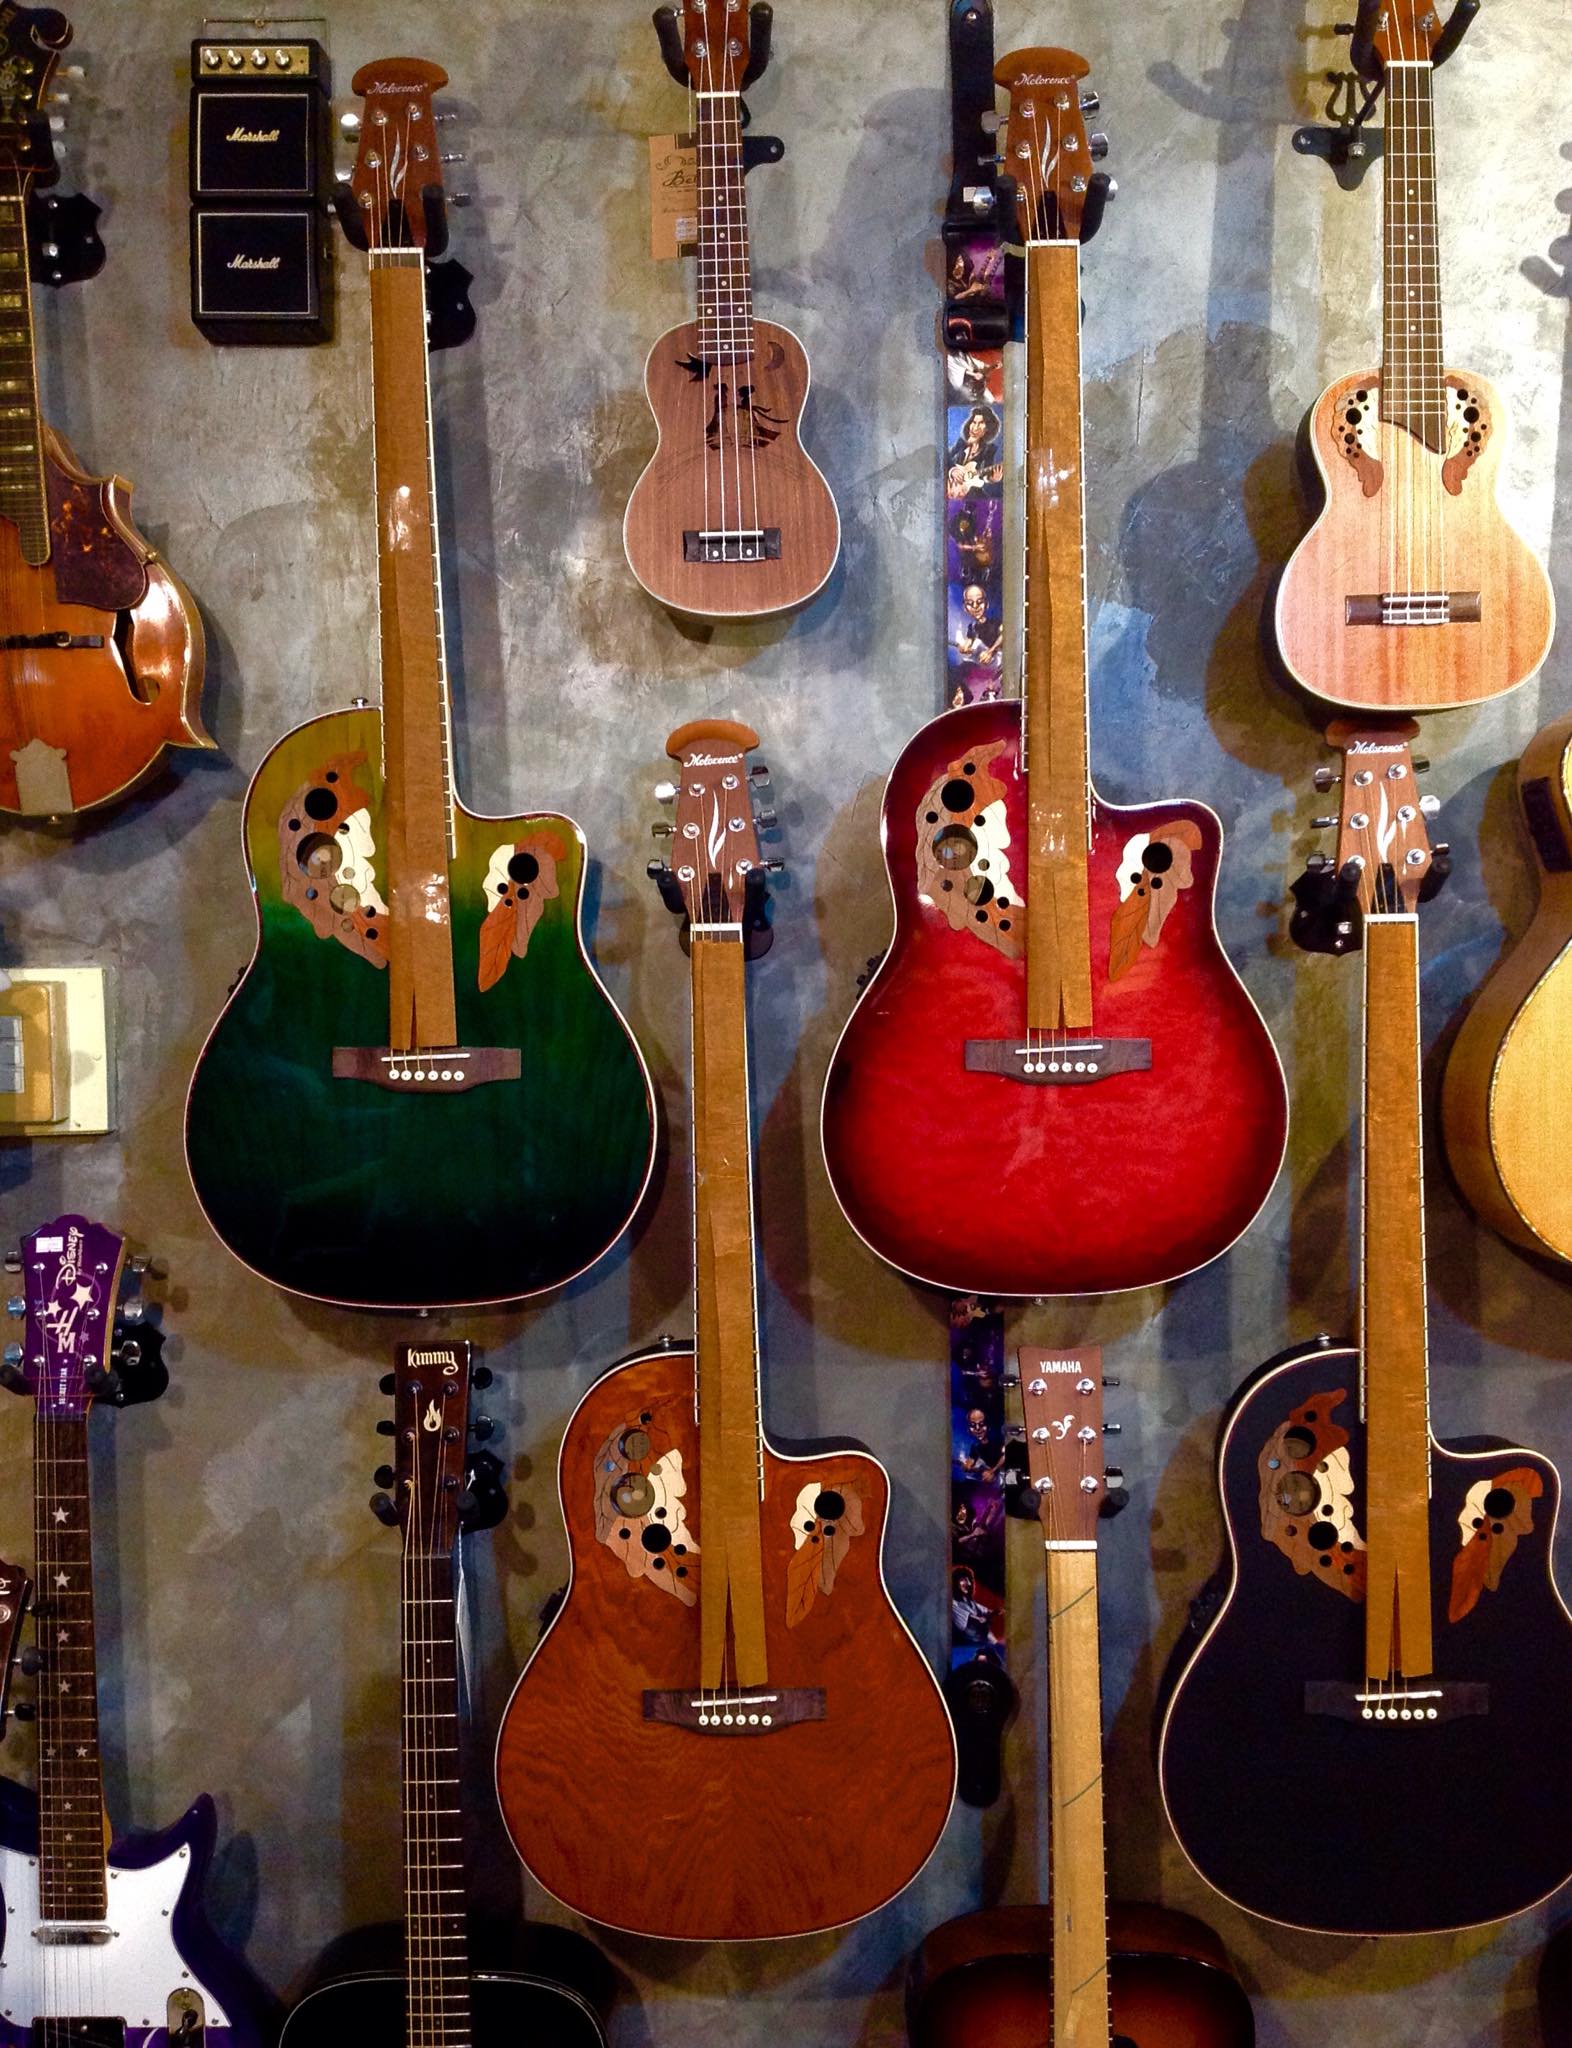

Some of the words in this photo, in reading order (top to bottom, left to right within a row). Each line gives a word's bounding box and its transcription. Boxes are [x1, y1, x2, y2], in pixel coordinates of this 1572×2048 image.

[225, 126, 281, 143] Marshall
[226, 253, 281, 270] Marshall
[407, 1348, 459, 1376] Kimmy
[1040, 1360, 1082, 1374] YAMAHA
